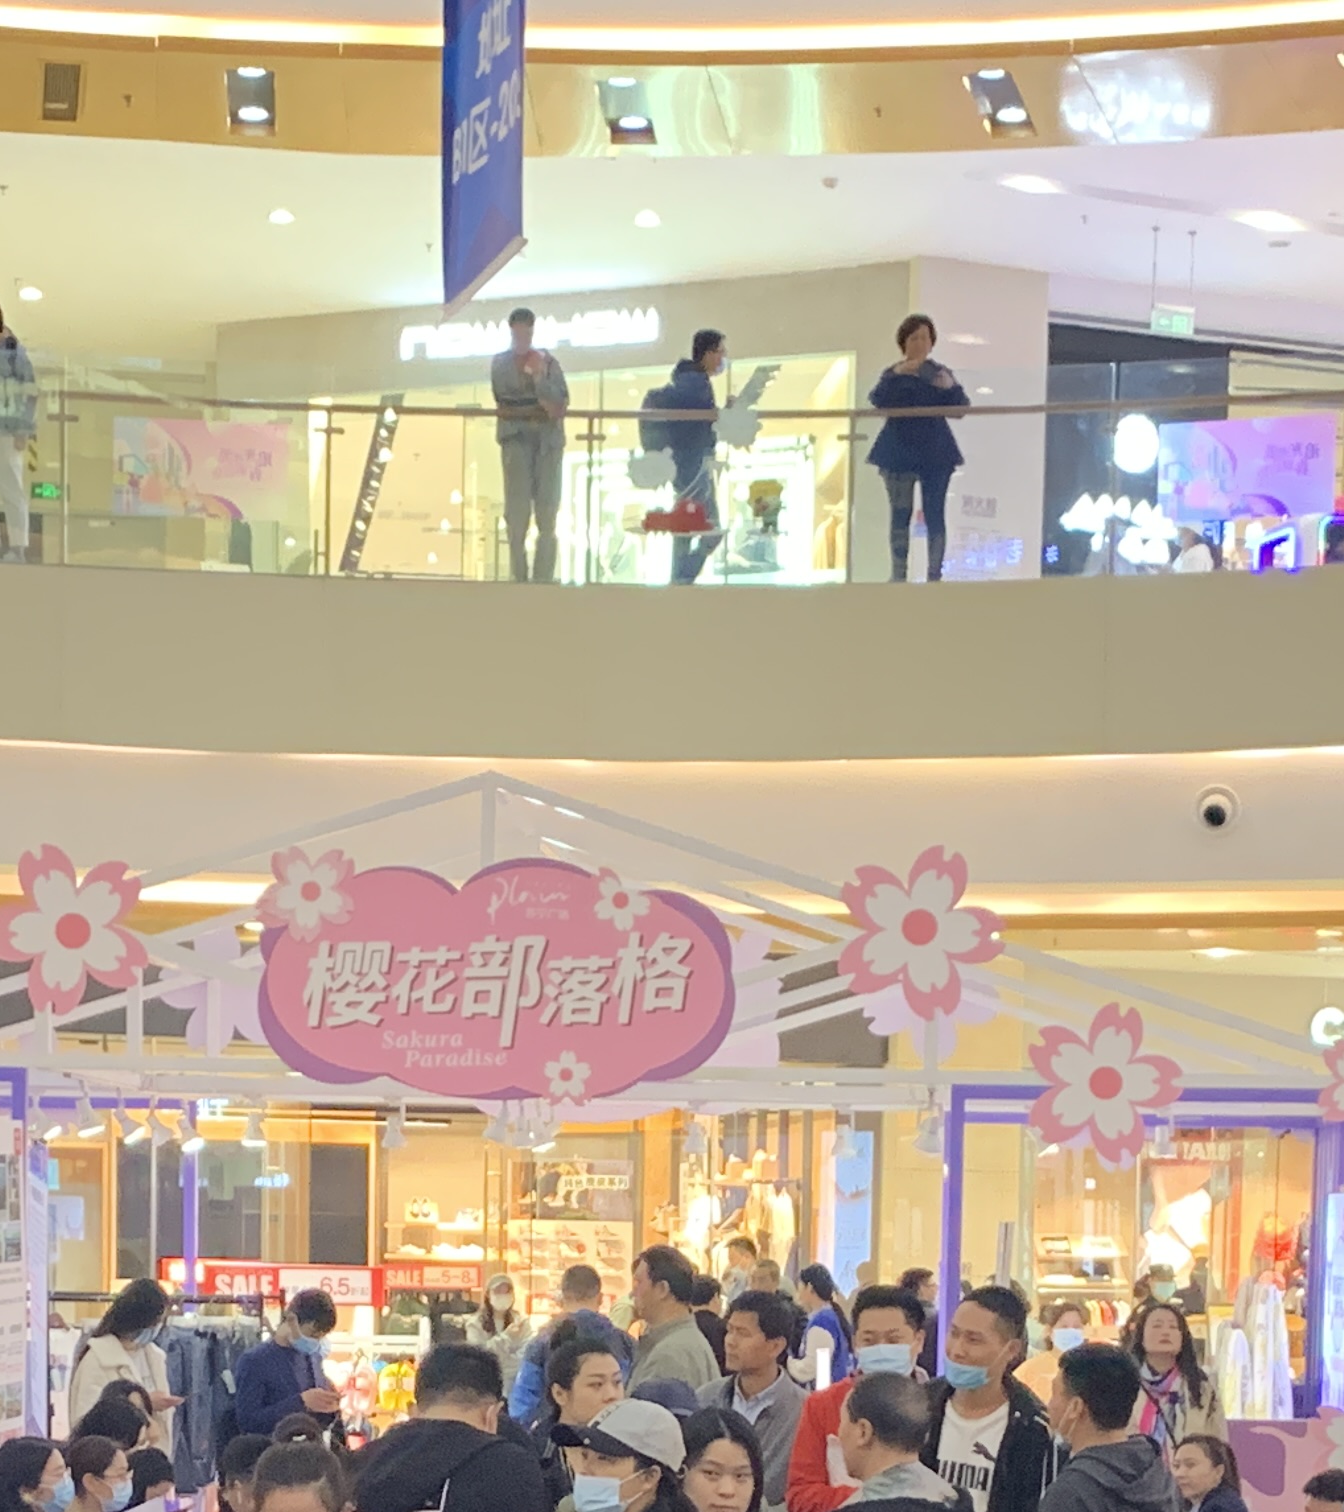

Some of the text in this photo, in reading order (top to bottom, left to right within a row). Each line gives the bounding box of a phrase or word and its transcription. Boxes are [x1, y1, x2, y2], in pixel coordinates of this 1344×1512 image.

[304, 932, 692, 1048] 樱花部落格
[382, 1030, 463, 1049] Sakura
[404, 1048, 507, 1069] Paradise
[214, 1273, 274, 1296] SALE
[387, 1269, 422, 1287] SALE
[940, 1460, 989, 1492] UMA
